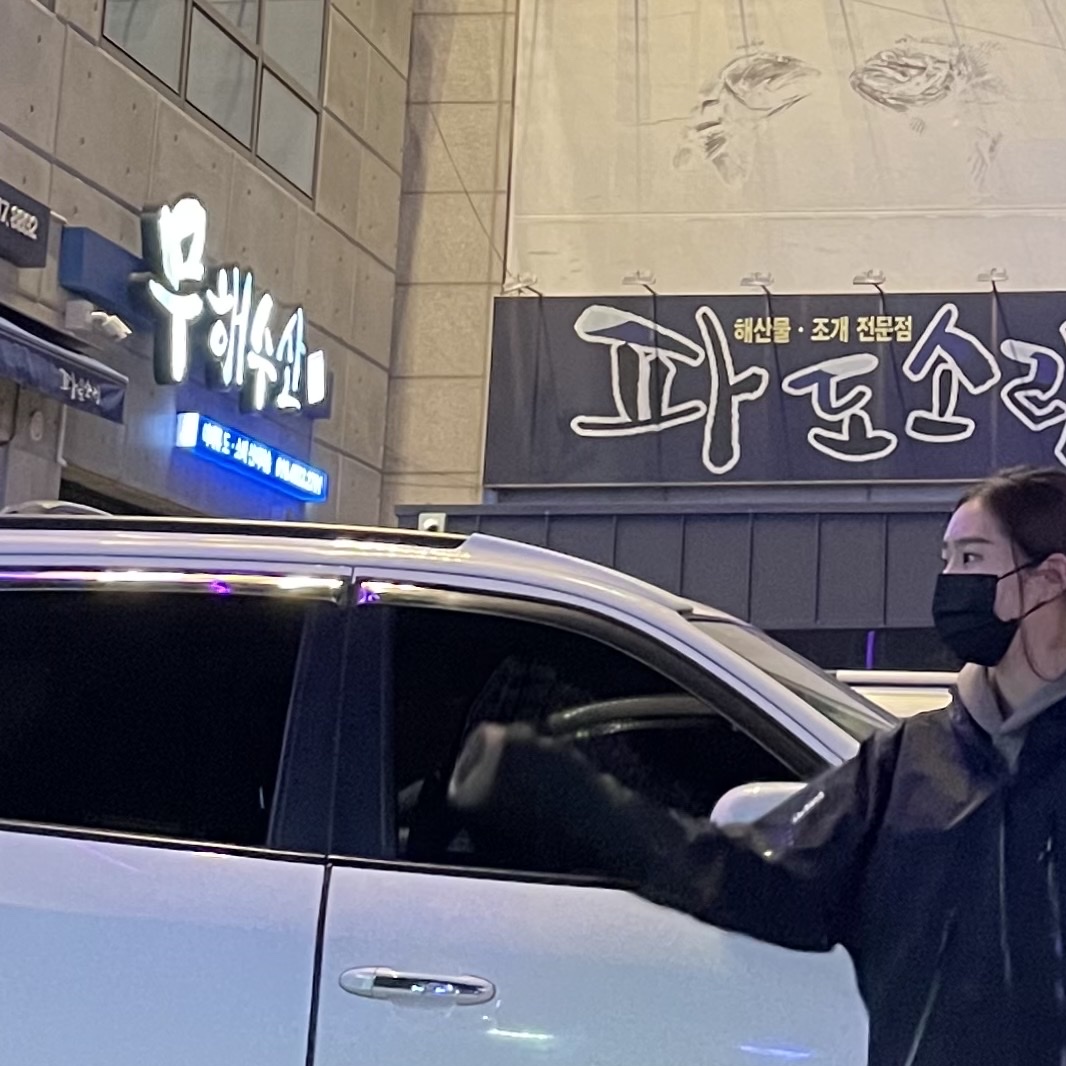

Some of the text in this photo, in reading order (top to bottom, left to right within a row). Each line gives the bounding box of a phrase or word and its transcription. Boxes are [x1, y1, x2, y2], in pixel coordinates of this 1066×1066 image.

[734, 315, 912, 343] 해산물 조개 전문점
